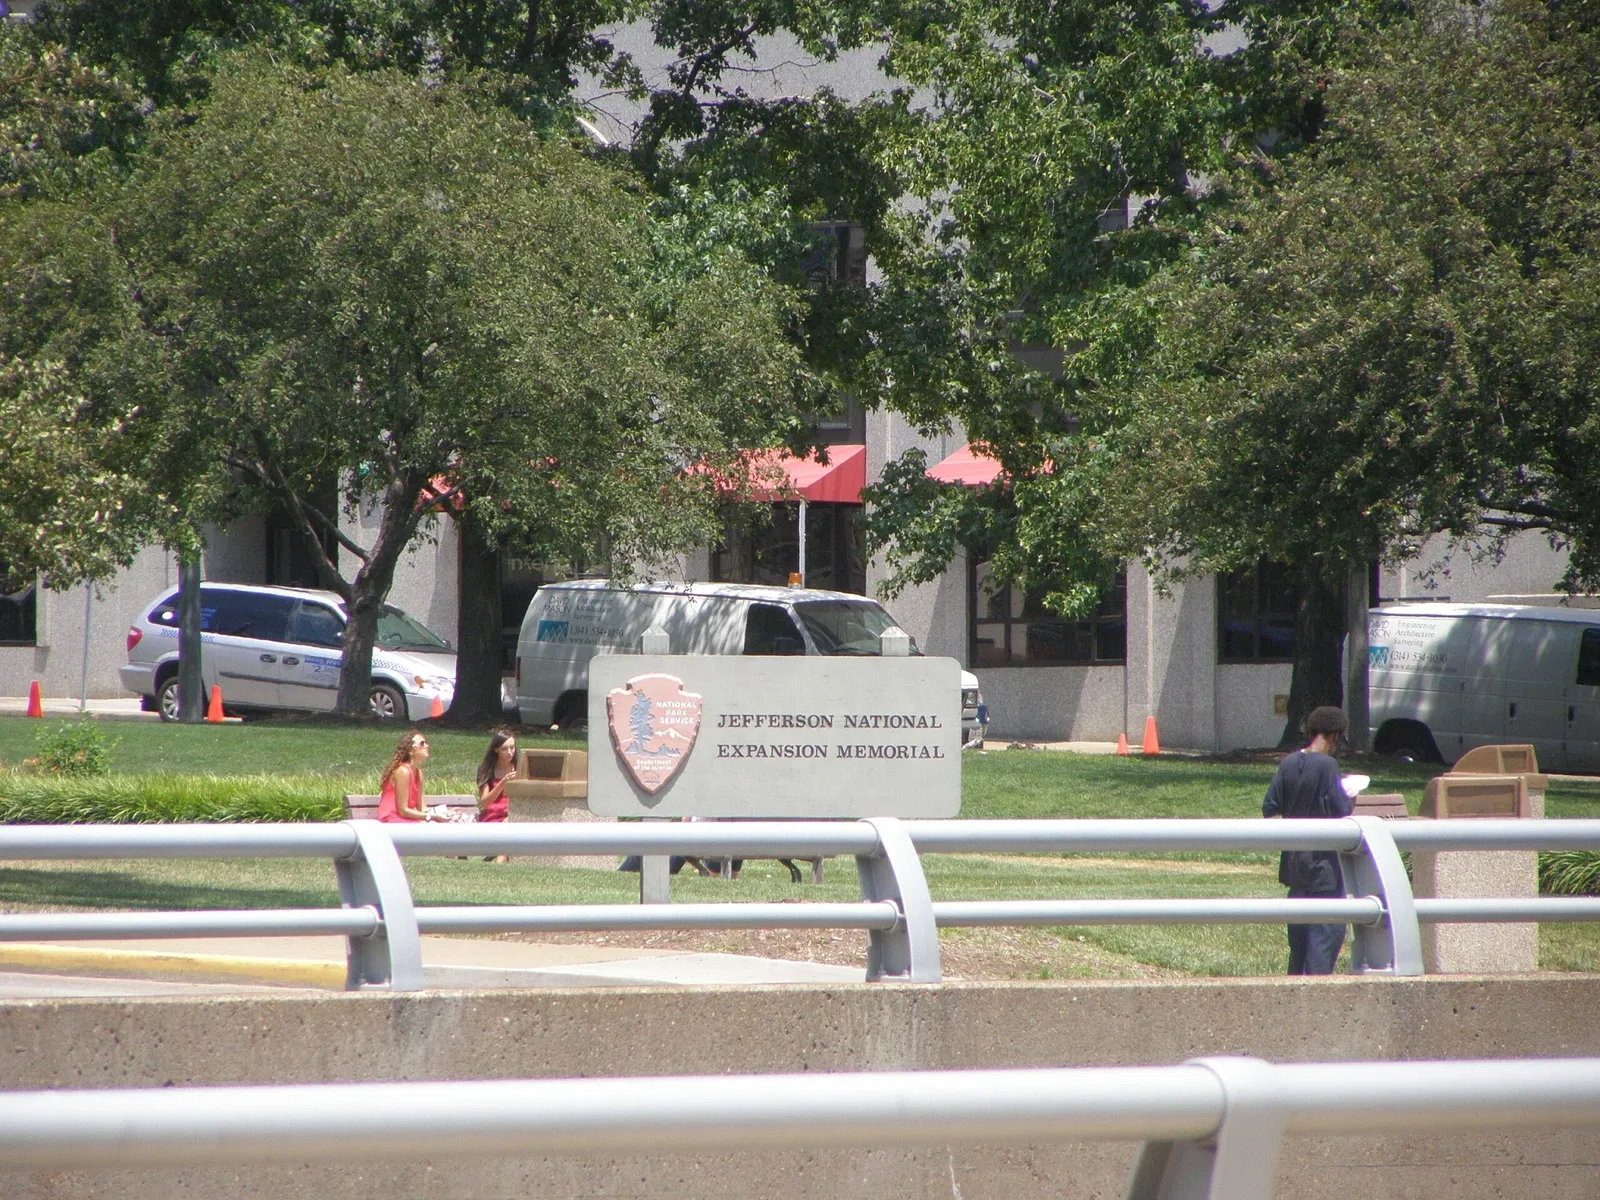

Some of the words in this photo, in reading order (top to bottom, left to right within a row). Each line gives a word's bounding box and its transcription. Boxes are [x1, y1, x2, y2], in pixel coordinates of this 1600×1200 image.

[543, 603, 571, 613] MASON
[1397, 620, 1437, 630] Engineering
[1368, 629, 1391, 638] ASON
[1395, 629, 1436, 638] Architecture
[1393, 637, 1425, 648] Surveying
[1390, 650, 1410, 661] (314)
[656, 701, 697, 709] NATIONAL
[659, 717, 695, 725] SERVICE
[717, 714, 834, 729] JEFFERSON
[844, 714, 942, 729] NATIONAL
[717, 744, 828, 759] EXPANSION
[837, 744, 945, 759] MEMORIAL
